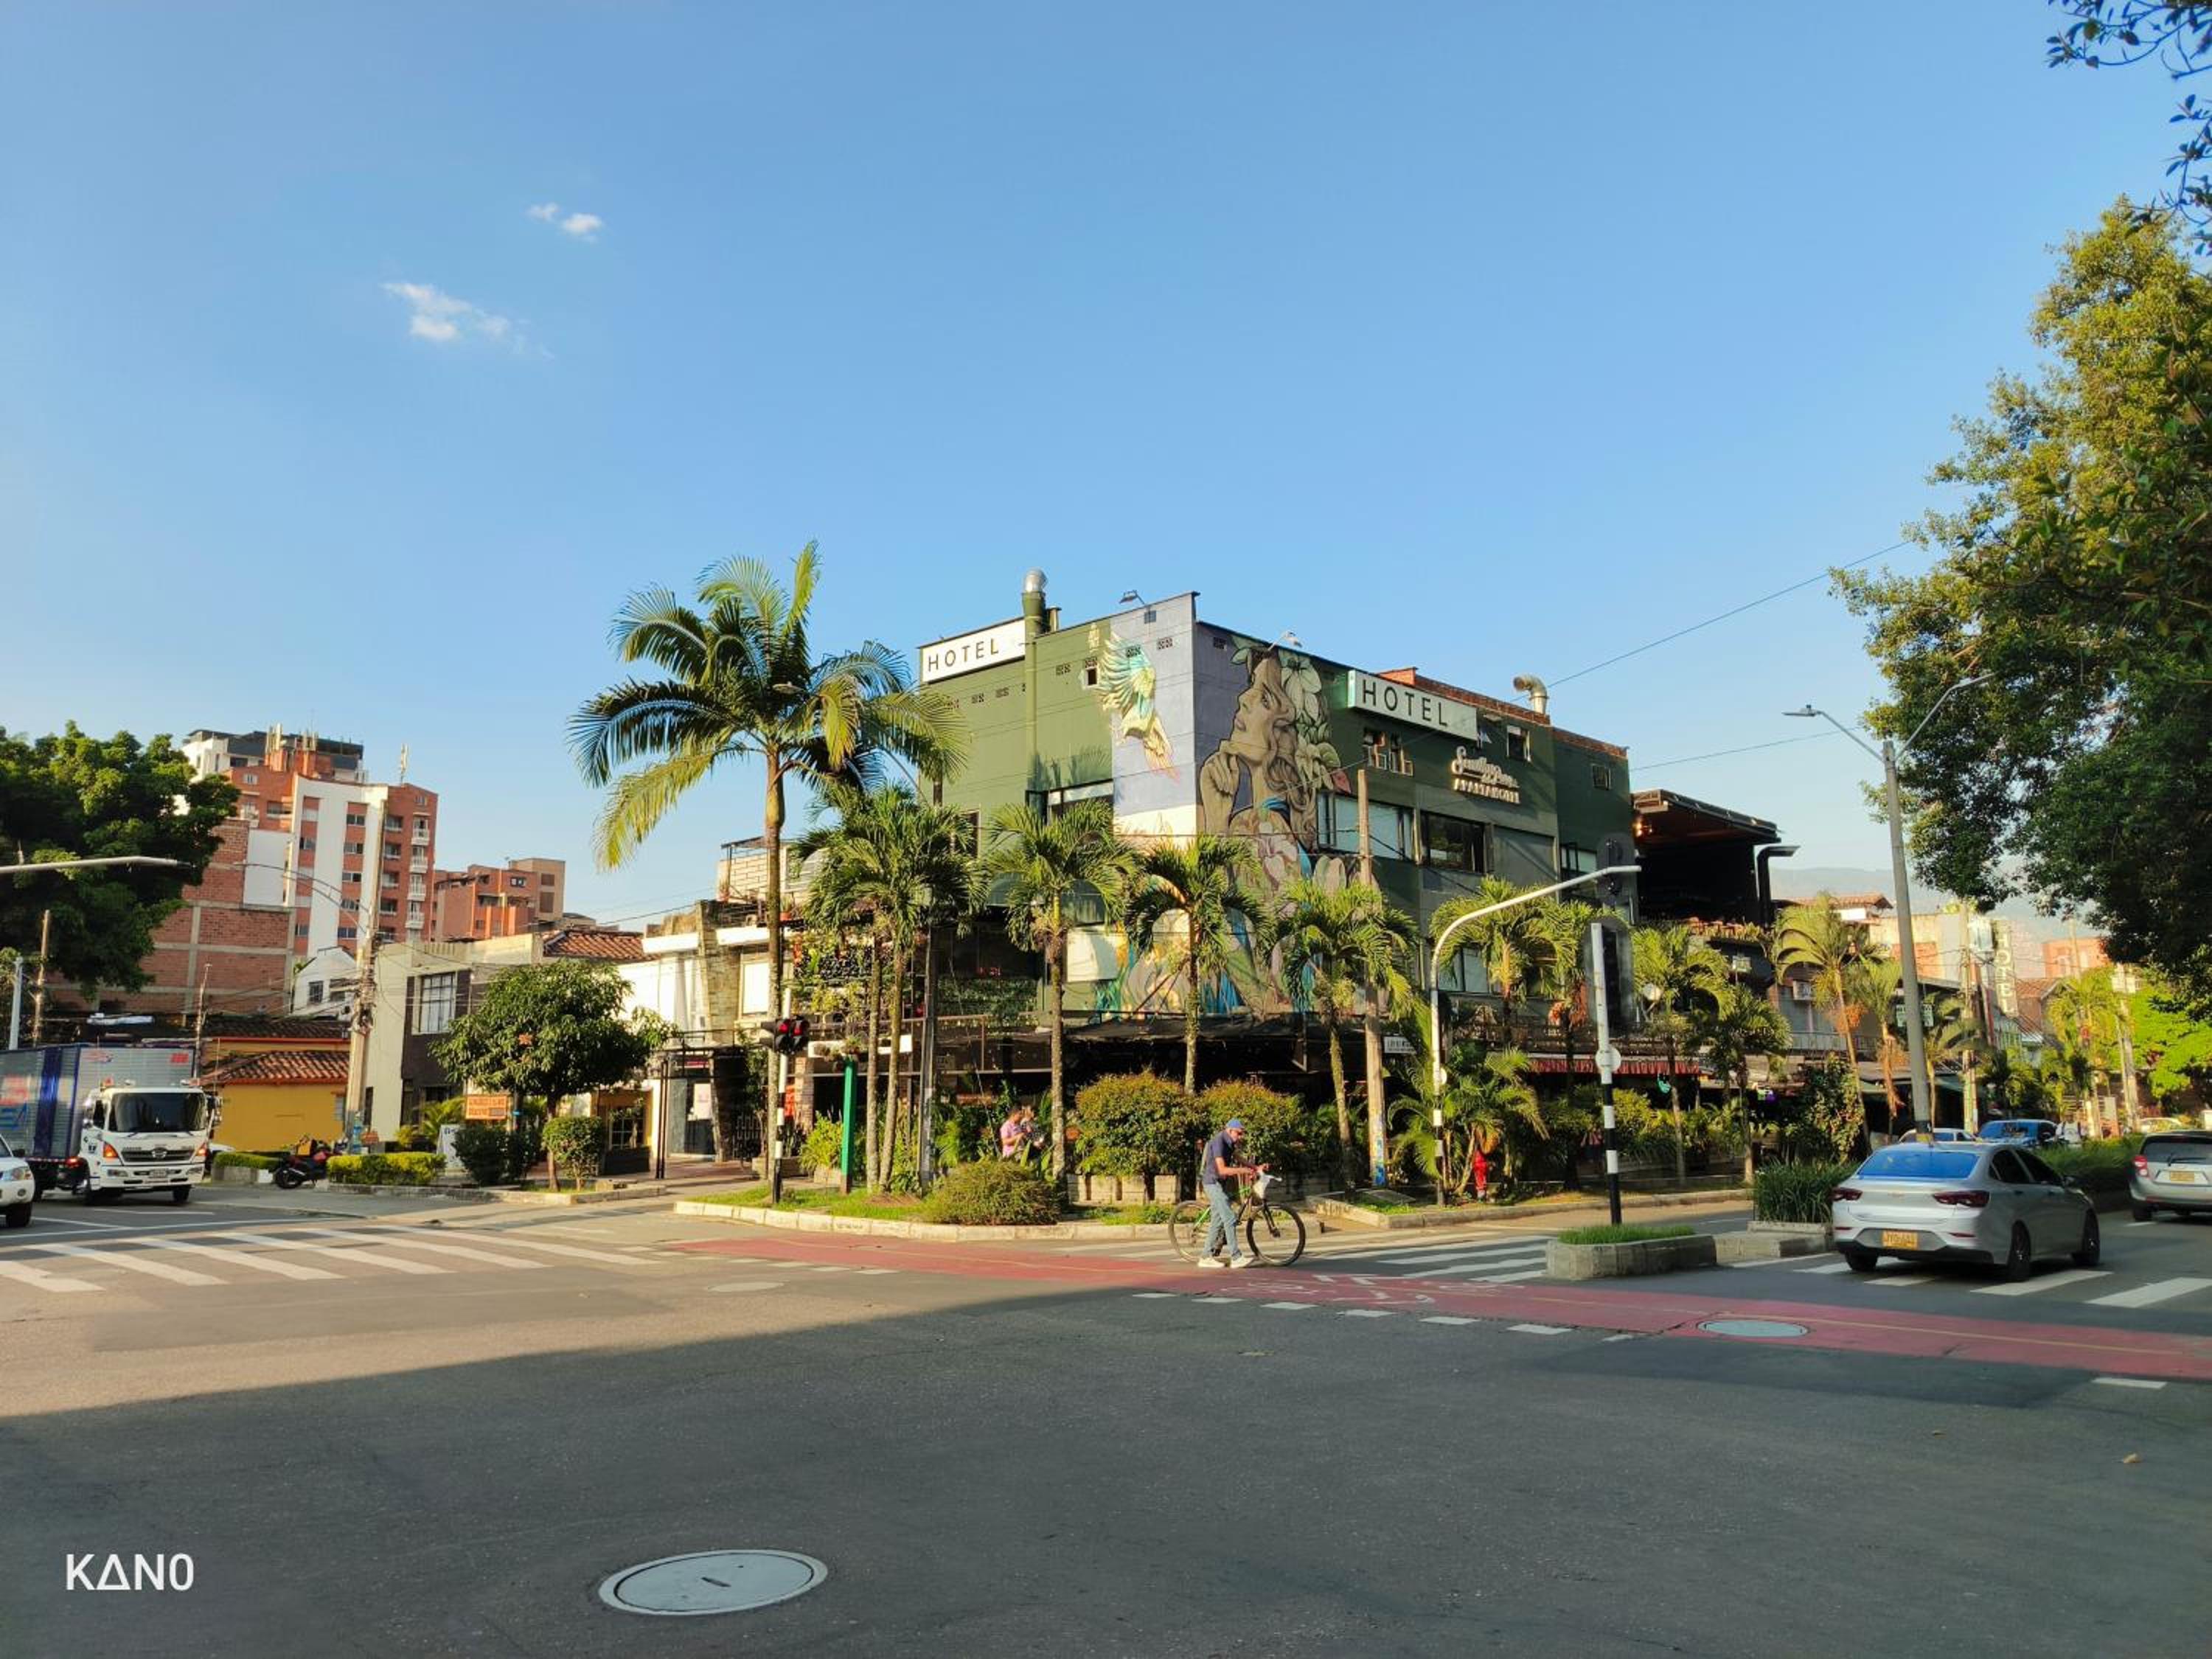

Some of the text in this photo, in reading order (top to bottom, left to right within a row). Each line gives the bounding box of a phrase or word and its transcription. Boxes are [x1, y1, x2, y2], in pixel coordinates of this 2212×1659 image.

[928, 638, 999, 672] HOTEL
[1363, 679, 1447, 726] HOTEL
[1997, 931, 2015, 1015] HOTEL
